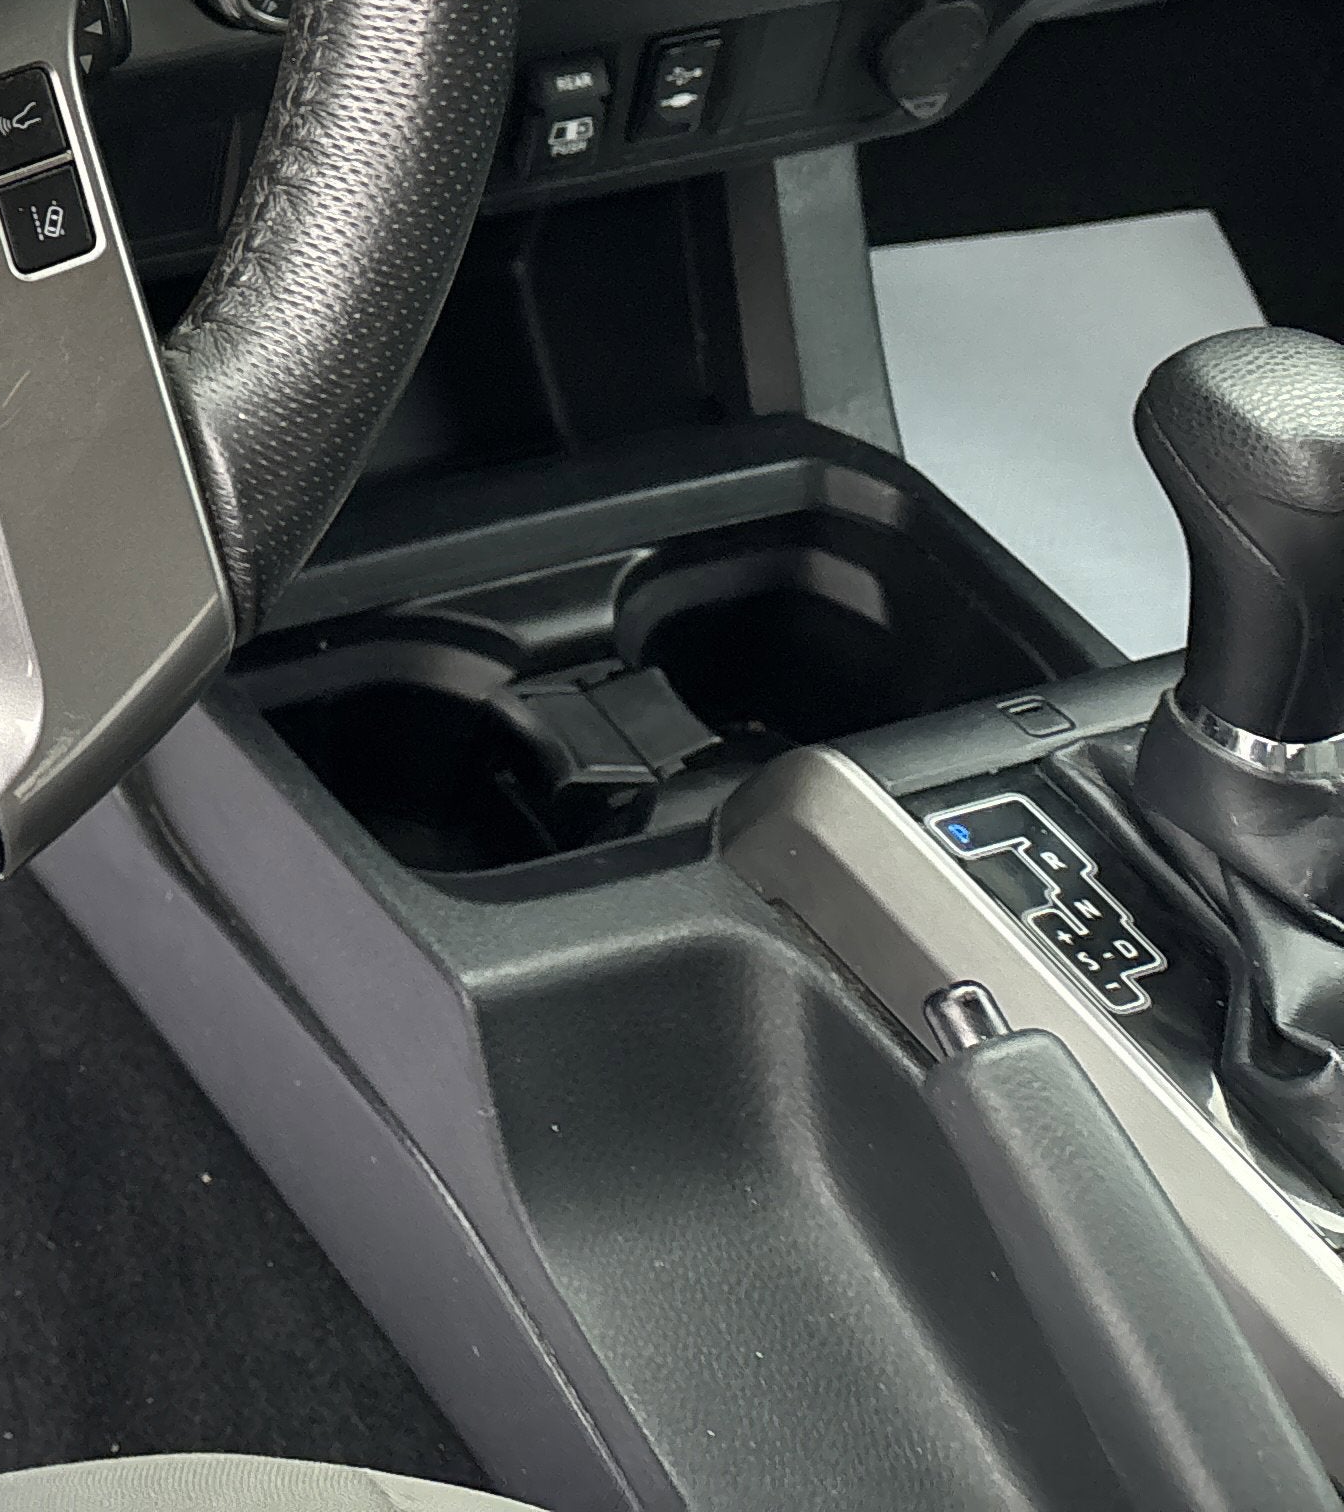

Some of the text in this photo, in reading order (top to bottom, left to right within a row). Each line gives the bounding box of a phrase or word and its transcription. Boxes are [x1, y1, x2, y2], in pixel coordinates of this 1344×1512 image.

[1040, 851, 1068, 870] R
[1073, 899, 1103, 919] N
[1113, 939, 1138, 959] D
[1077, 951, 1101, 971] S
